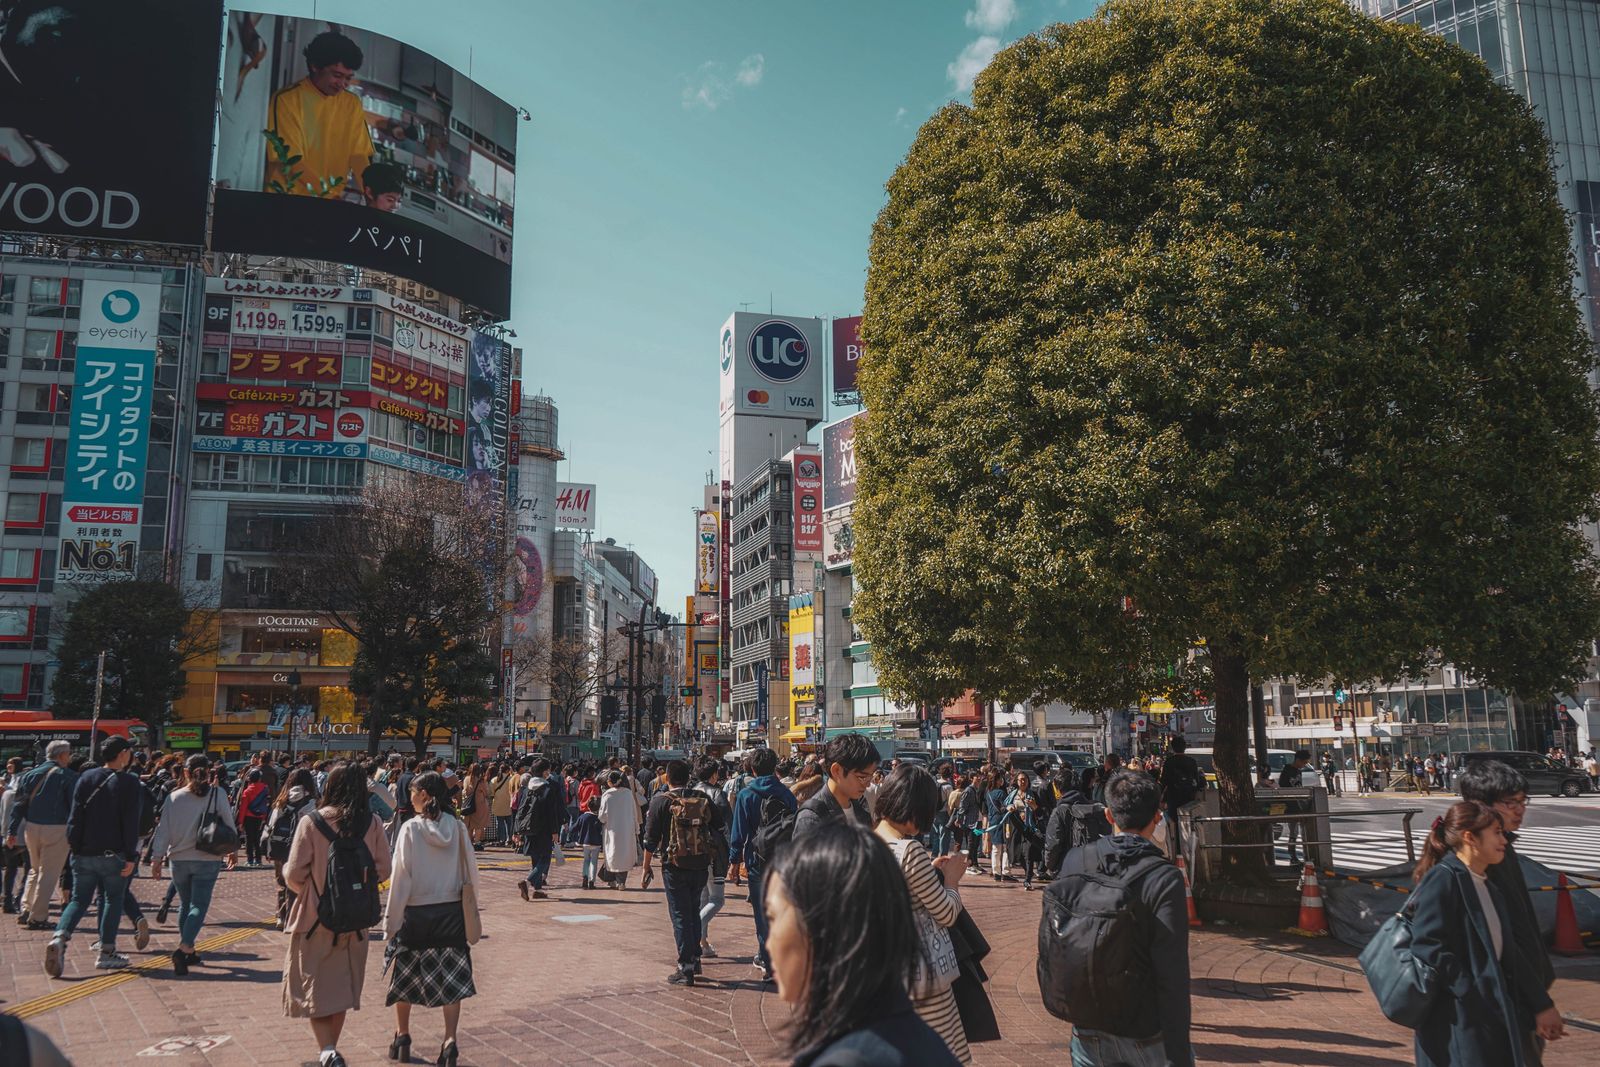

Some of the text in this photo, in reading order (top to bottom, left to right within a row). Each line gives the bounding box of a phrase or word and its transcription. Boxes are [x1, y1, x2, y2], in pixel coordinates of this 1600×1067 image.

[224, 280, 342, 299] しゃぶしゃぶバイキング
[208, 307, 229, 320] 9F
[89, 327, 147, 343] eyecity
[419, 331, 464, 362] しゃぶ葉
[231, 352, 338, 376] プライス
[371, 361, 445, 400] コンタクト
[299, 389, 350, 408] ガスト
[789, 396, 815, 407] VISA
[77, 361, 117, 490] アイシティ
[198, 412, 224, 427] 7F
[230, 412, 260, 424] Café
[262, 411, 328, 437] ガスト
[426, 411, 459, 434] ガスト
[113, 362, 144, 491] コンタクトの
[340, 423, 362, 431] ガスト
[199, 439, 231, 448] AEON
[242, 439, 338, 455] 英会話イーオン
[345, 445, 360, 453] 6F
[374, 448, 397, 459] AEON
[402, 454, 465, 479] 英会話イーオン
[556, 488, 591, 512] H&M
[76, 508, 133, 522] 当ビル5階
[76, 527, 123, 537] 利用者数
[258, 615, 319, 626] L'OCCITANE
[272, 672, 289, 683] Ca
